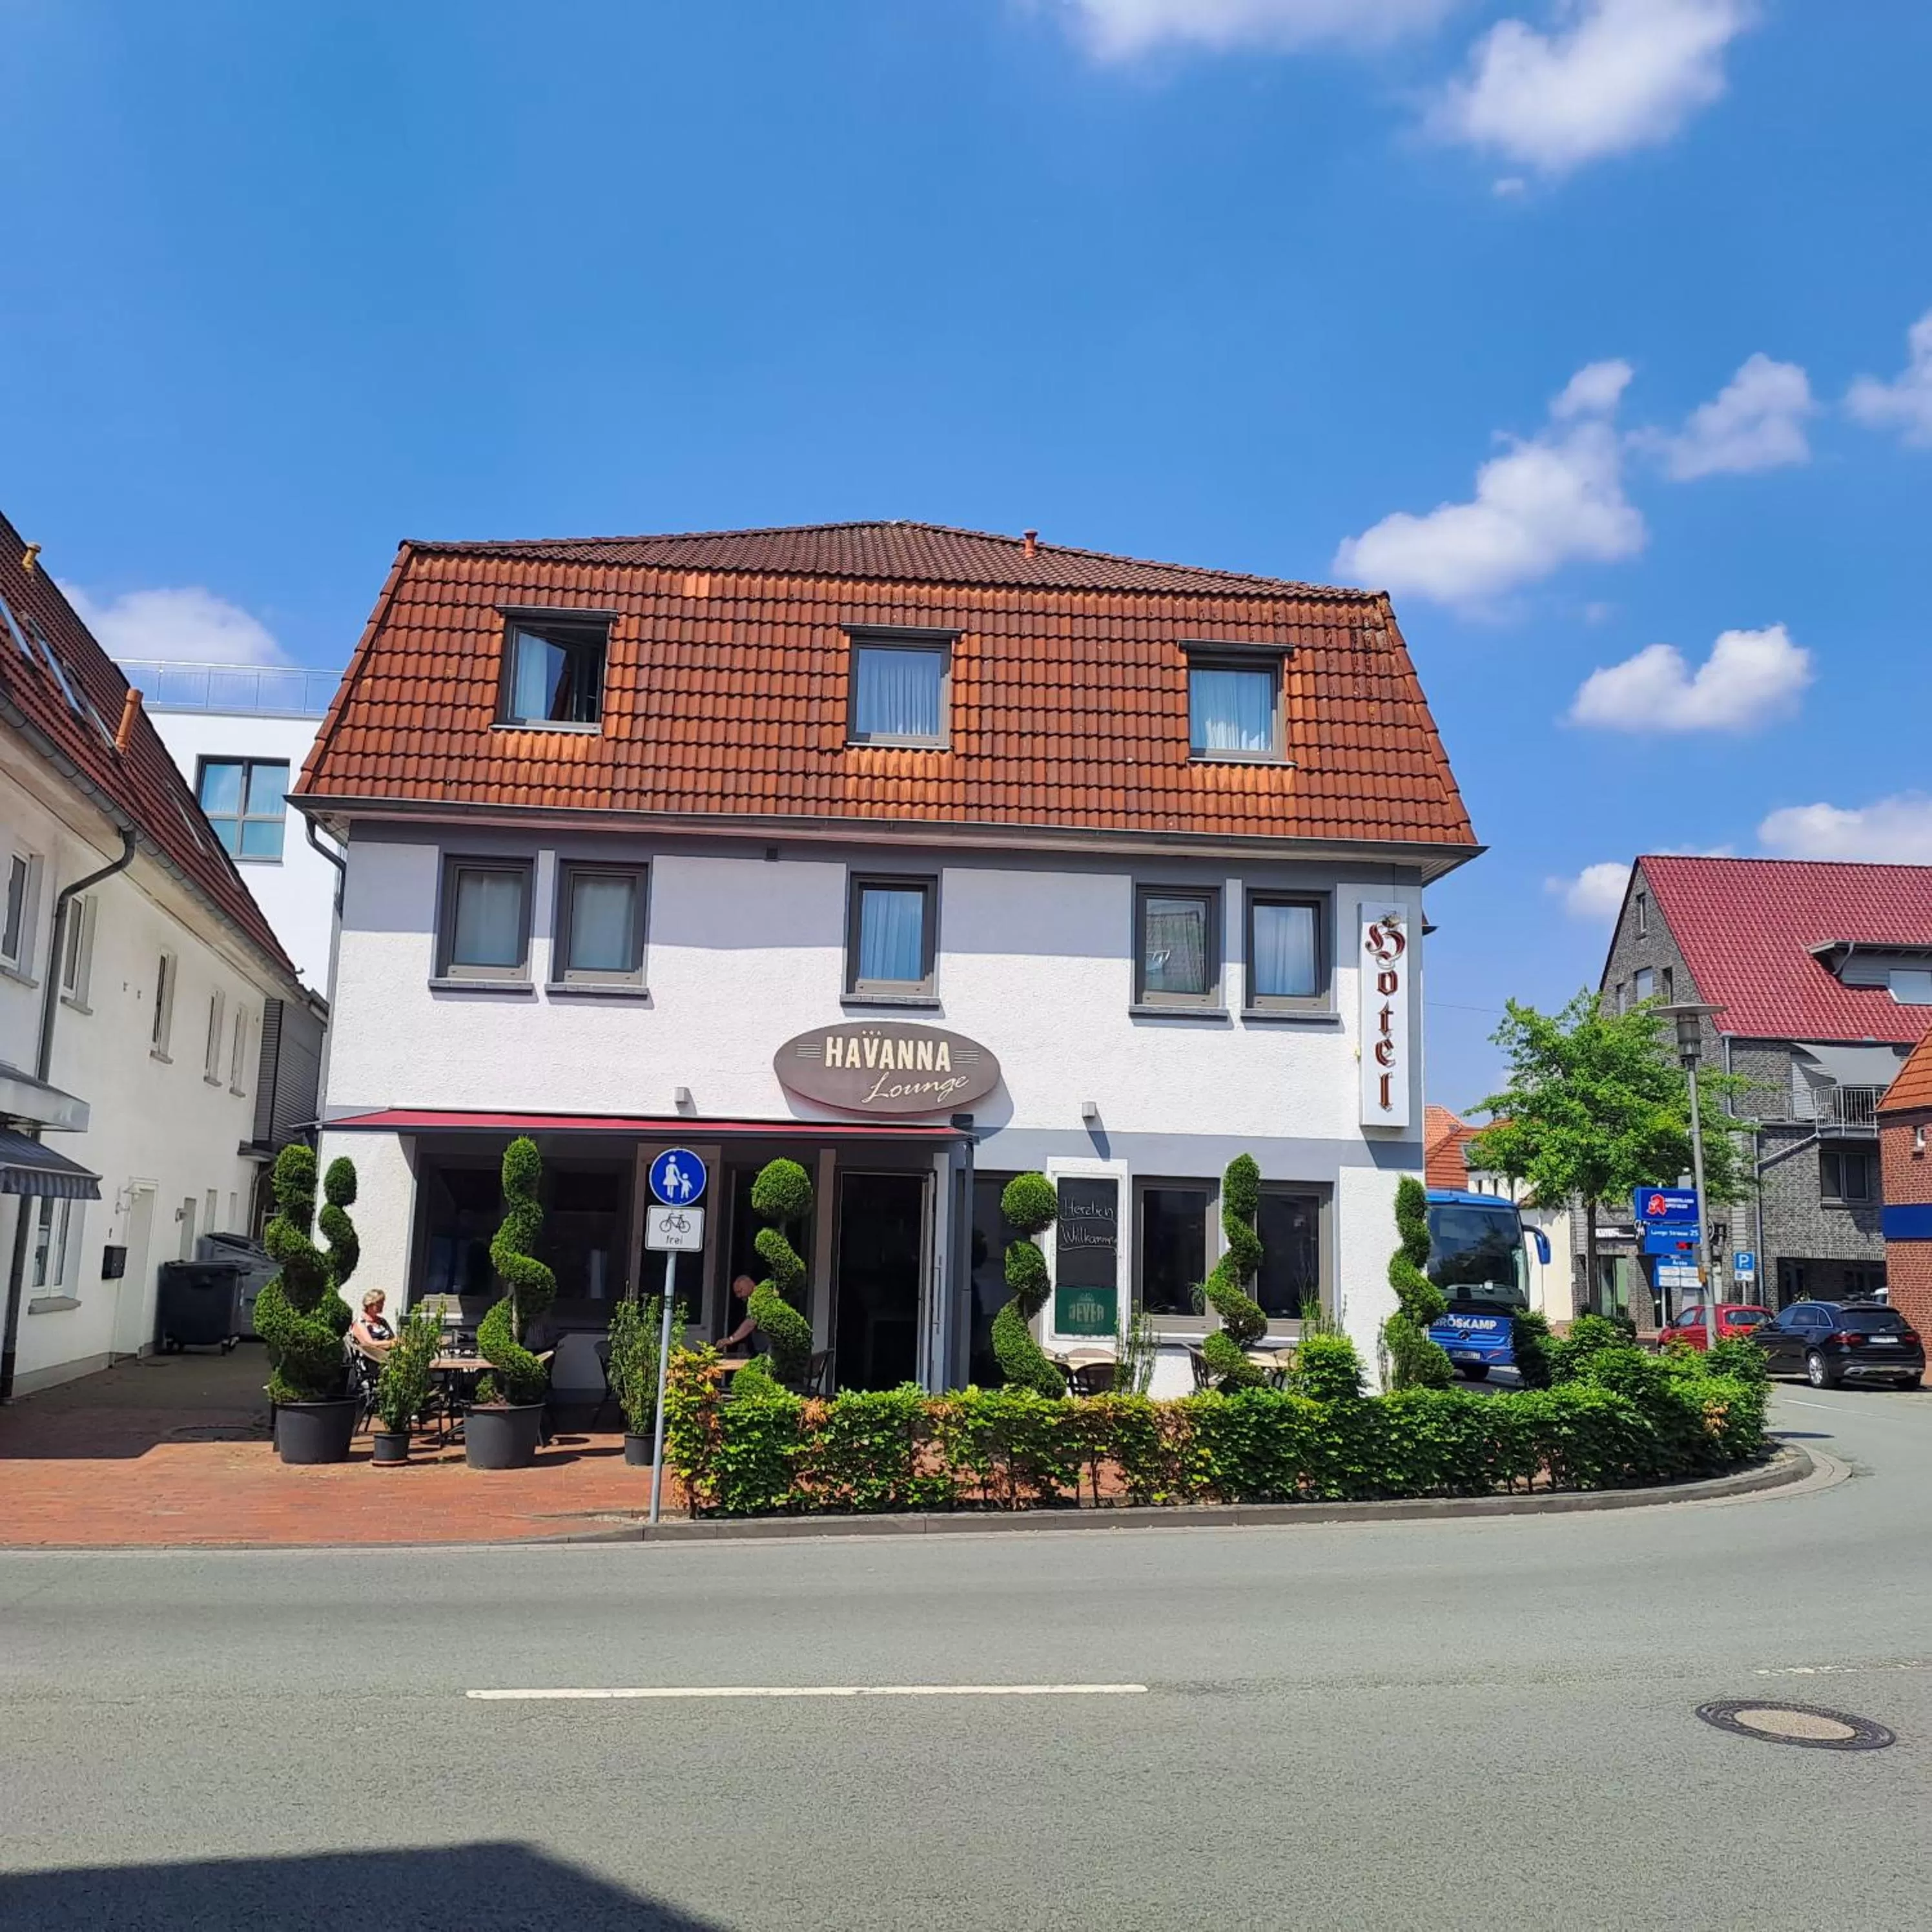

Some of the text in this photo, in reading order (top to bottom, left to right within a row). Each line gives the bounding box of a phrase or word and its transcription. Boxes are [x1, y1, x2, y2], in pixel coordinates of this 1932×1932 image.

[1365, 922, 1406, 1113] Hotel
[825, 1036, 951, 1072] HAVANNA
[861, 1072, 969, 1104] Lounge
[666, 1235, 683, 1246] frei
[1061, 1224, 1117, 1245] Willkomm
[1069, 1302, 1104, 1322] JEVER
